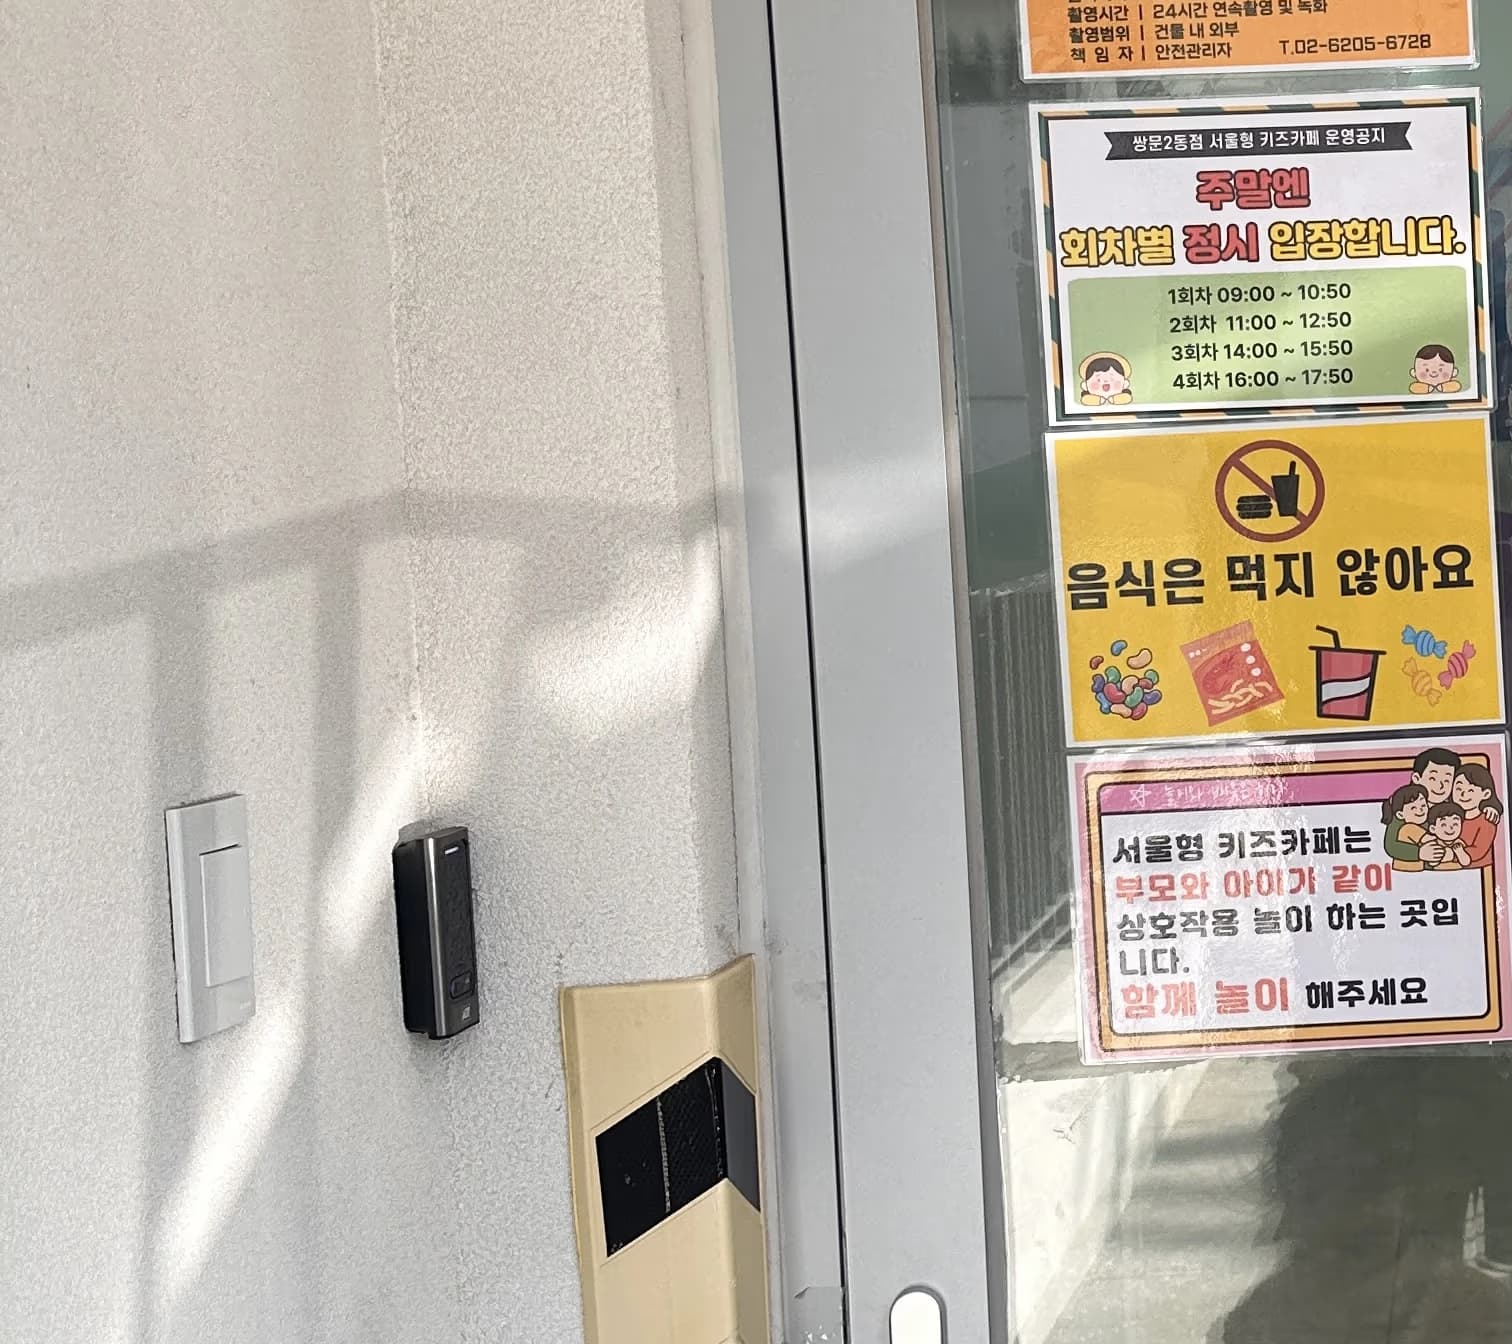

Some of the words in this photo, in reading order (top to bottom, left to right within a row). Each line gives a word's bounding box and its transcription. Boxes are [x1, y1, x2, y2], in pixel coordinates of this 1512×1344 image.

[1067, 6, 1128, 23] 촬영시간
[1154, 2, 1208, 20] 24시간
[1213, 0, 1273, 17] 연속촬영
[1279, 0, 1292, 15] 및
[1069, 25, 1130, 43] 촬영범위
[1155, 23, 1184, 40] 건물
[1190, 22, 1204, 39] 내
[1209, 22, 1239, 38] 외부
[1156, 43, 1232, 61] 안전관리자
[1132, 136, 1203, 152] 쌍문2동점
[1210, 133, 1253, 150] 서울형
[1260, 130, 1319, 147] 키즈카페
[1326, 127, 1385, 145] 운영공지
[1195, 167, 1311, 210] 주말엔
[1059, 224, 1174, 268] 회차별
[1182, 223, 1259, 264] 정시
[1268, 215, 1466, 261] 입장합니다.
[1168, 287, 1212, 306] 1회차
[1217, 286, 1275, 303] 09:00
[1298, 283, 1351, 300] 10:50
[1169, 315, 1216, 334] 2회차
[1226, 314, 1276, 332] 11:00
[1300, 312, 1351, 329] 12:50
[1171, 344, 1218, 363] 3회차
[1224, 342, 1278, 360] 14:00
[1301, 340, 1353, 357] 15:50
[1172, 372, 1219, 391] 4회차
[1225, 371, 1279, 388] 16:00
[1302, 368, 1353, 385] 17:50
[1067, 557, 1205, 610] 음식은
[1226, 551, 1314, 600] 먹지
[1336, 544, 1474, 597] 않아요
[1112, 832, 1204, 864] 서울형
[1218, 826, 1371, 860] 키즈카페는
[1115, 871, 1209, 903] 부모와
[1223, 866, 1315, 898] 아이가
[1333, 863, 1392, 893] 같이
[1117, 909, 1239, 941] 상호작용
[1254, 905, 1312, 935] 놀이
[1326, 901, 1386, 932] 하는
[1400, 897, 1459, 928] 곳입
[1119, 947, 1190, 976] 니다.
[1120, 982, 1197, 1019] 함께
[1215, 977, 1288, 1014] 놀이
[1306, 976, 1428, 1009] 해주세요
